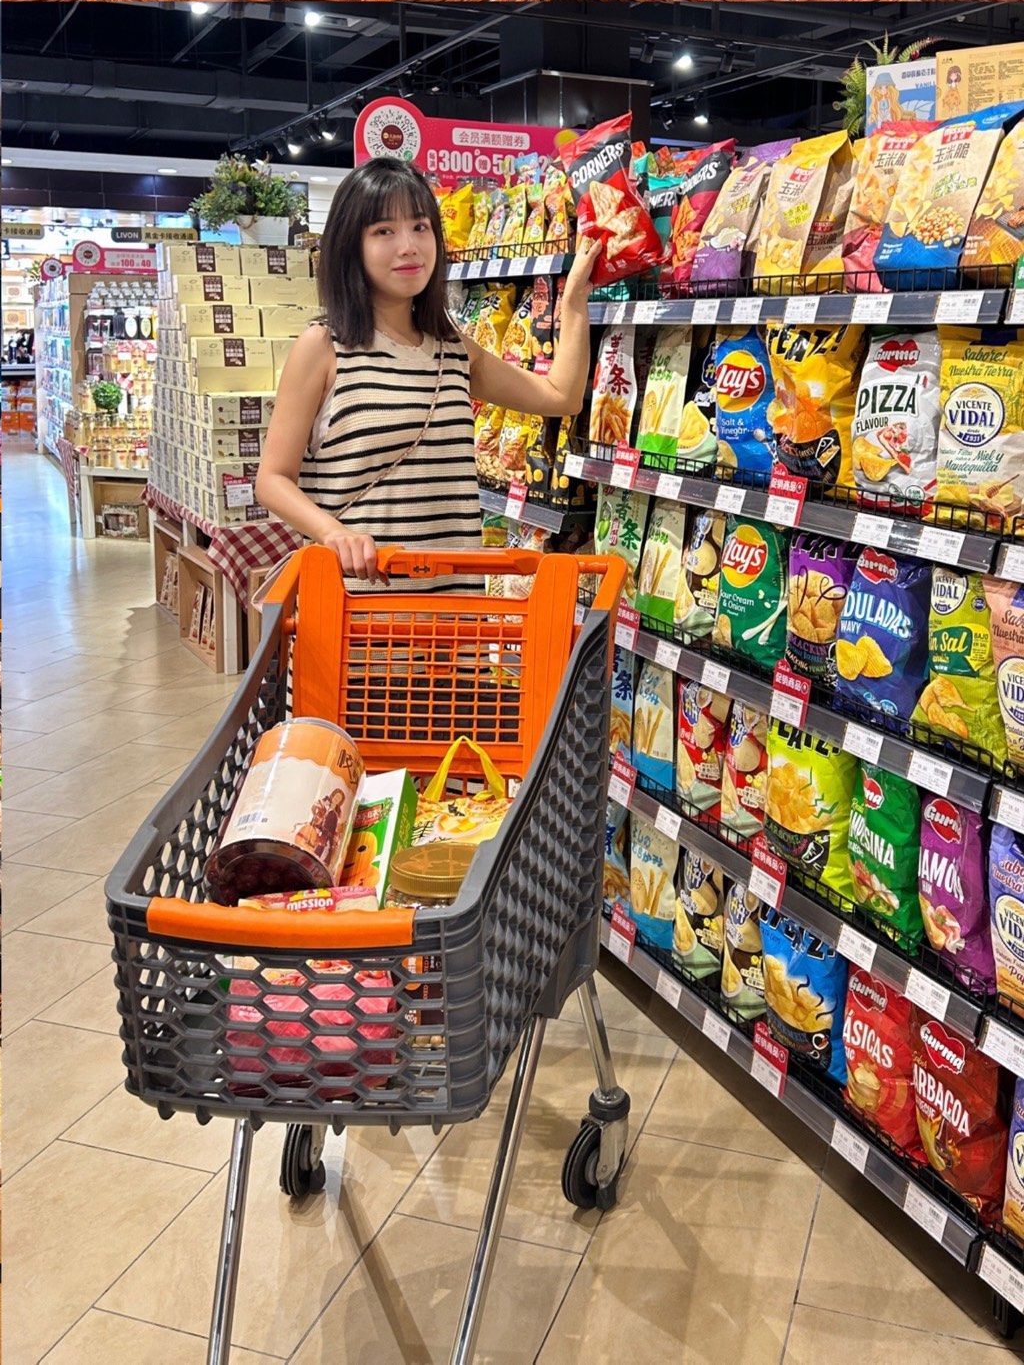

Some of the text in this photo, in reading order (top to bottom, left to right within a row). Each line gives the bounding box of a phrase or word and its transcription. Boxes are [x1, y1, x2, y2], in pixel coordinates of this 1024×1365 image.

[459, 131, 526, 148] 会员满额赠券
[438, 150, 472, 173] 300
[933, 142, 971, 164] 玉米脆
[571, 142, 625, 188] CORNERS
[115, 232, 139, 240] LIVON
[716, 366, 761, 399] Lay's
[857, 384, 918, 418] PIZZA
[956, 400, 992, 411] VICENTE
[856, 416, 889, 434] FLAVOUR
[948, 409, 995, 427] VIDAL
[722, 538, 765, 574] Lay's
[732, 593, 754, 606] Cream
[840, 620, 861, 634] WAVY
[940, 631, 969, 653] Sal
[920, 1024, 966, 1071] Gurma
